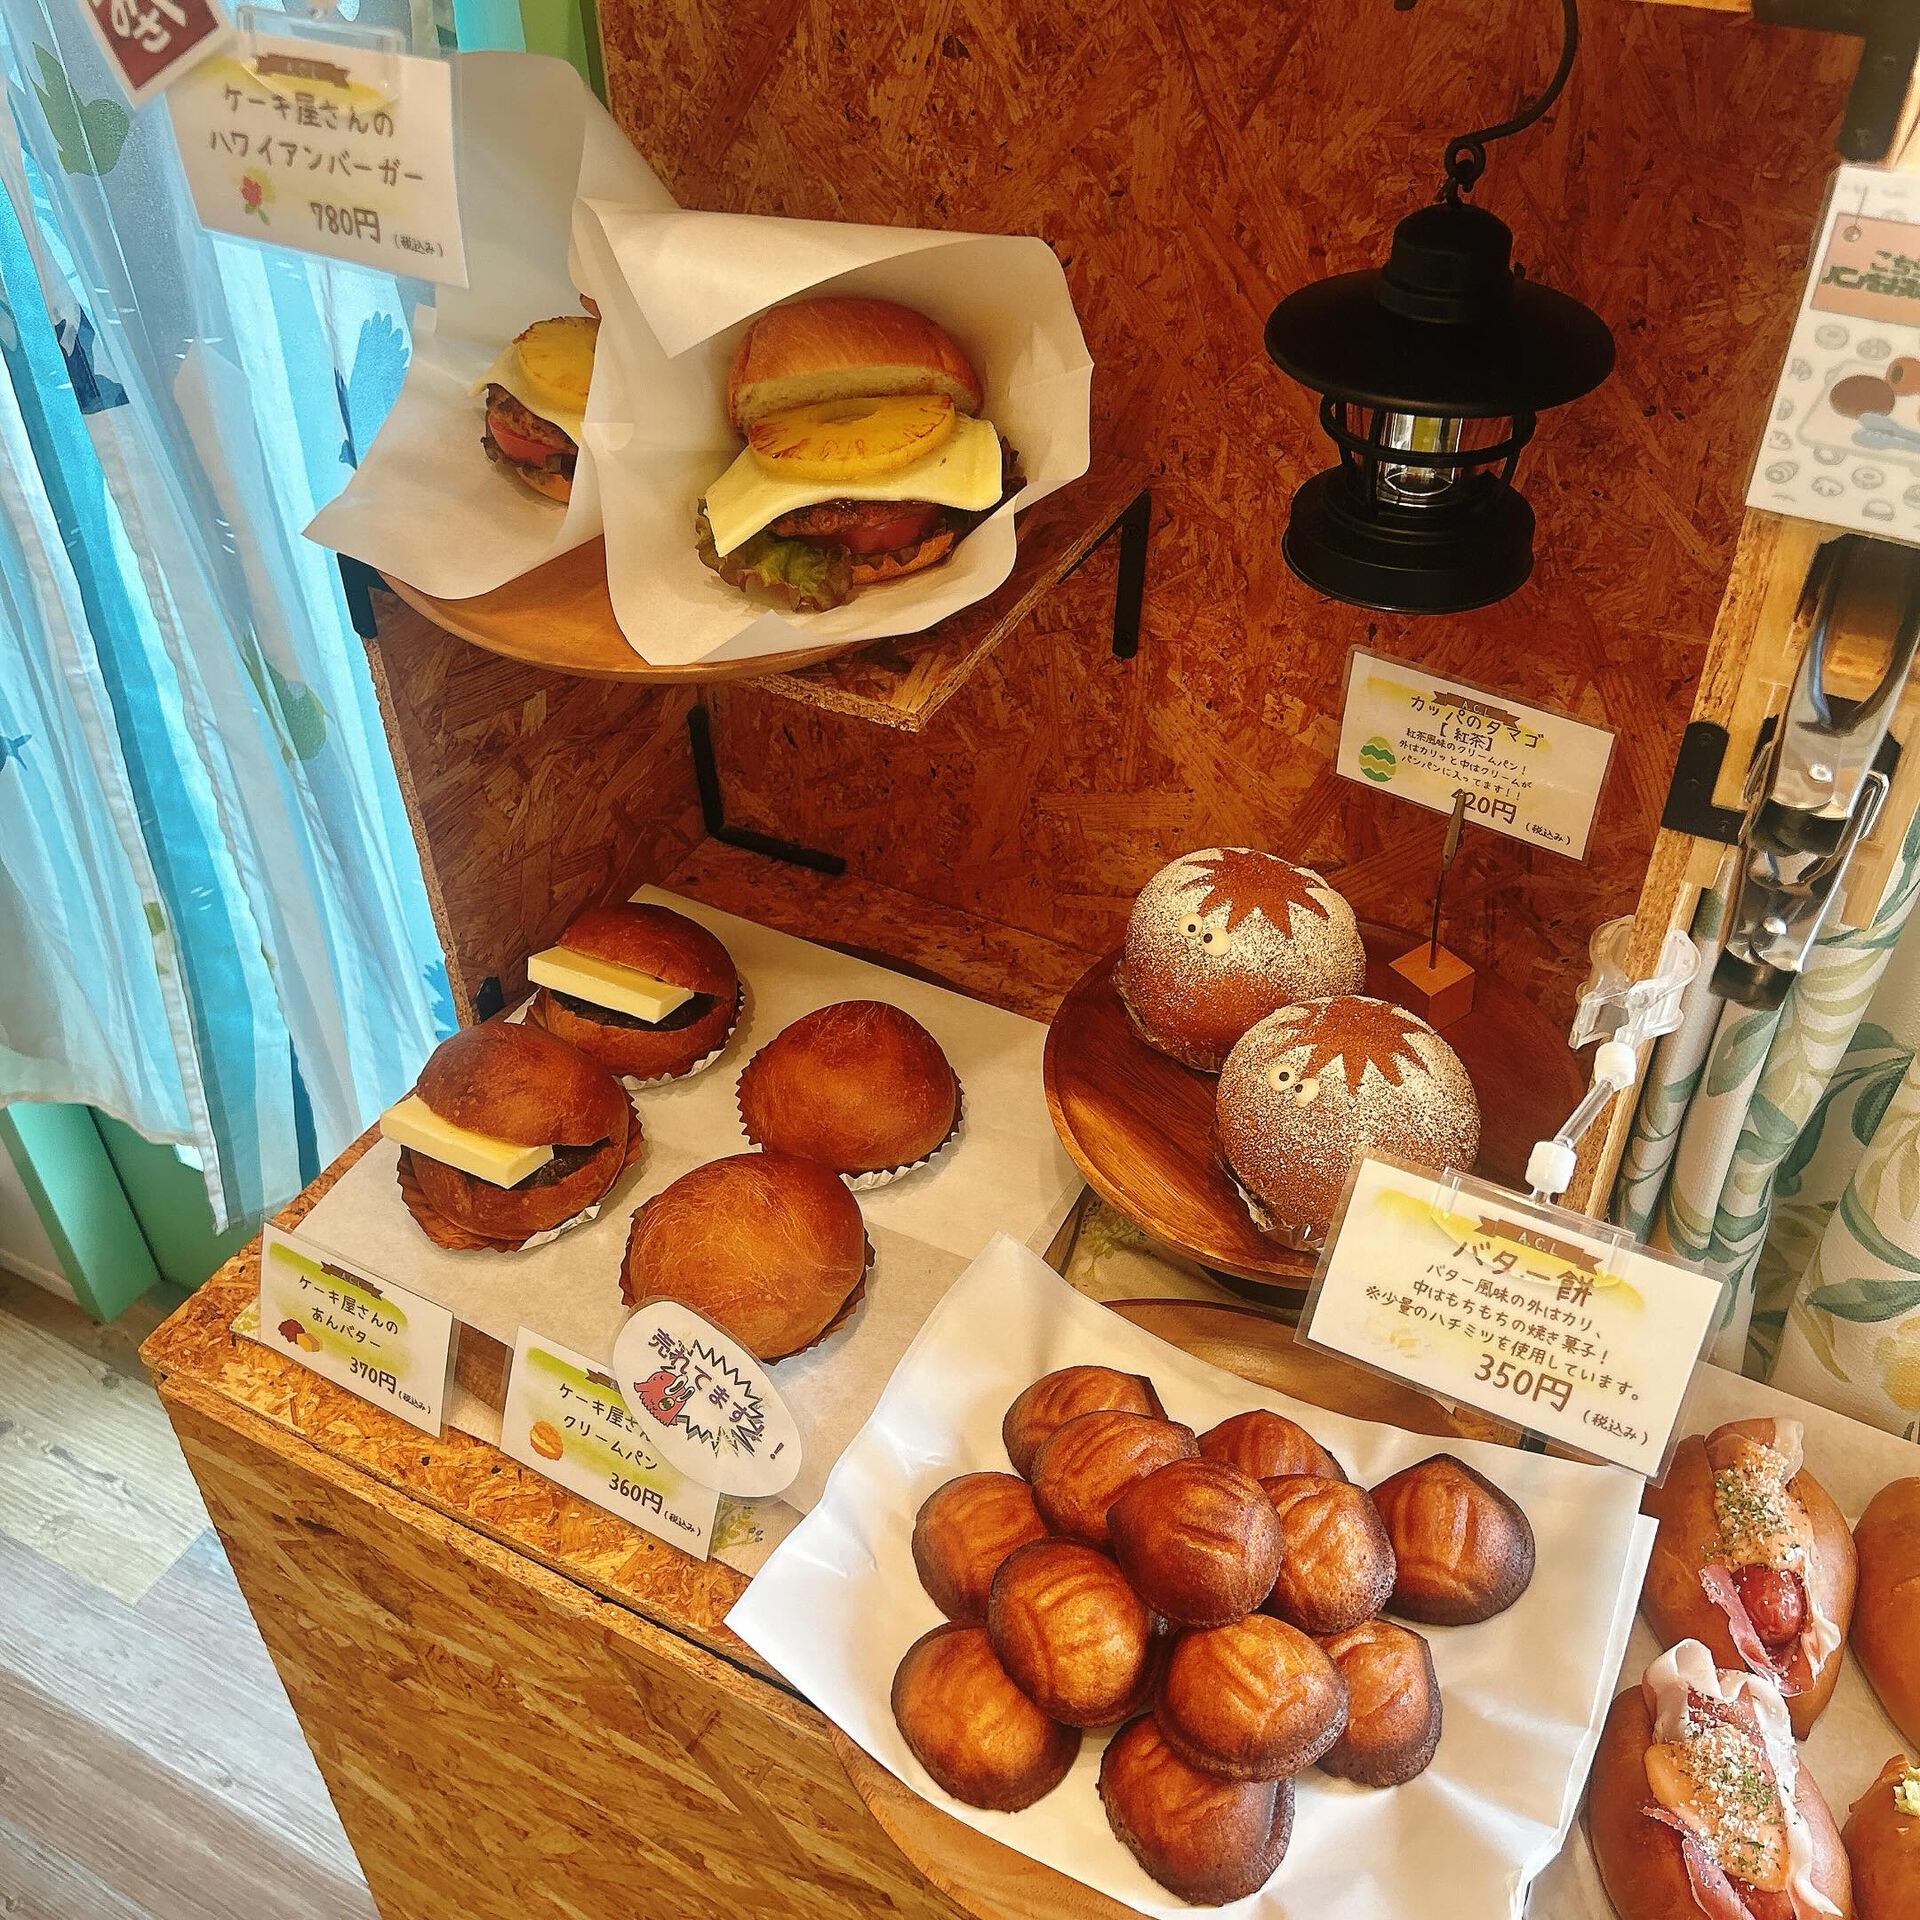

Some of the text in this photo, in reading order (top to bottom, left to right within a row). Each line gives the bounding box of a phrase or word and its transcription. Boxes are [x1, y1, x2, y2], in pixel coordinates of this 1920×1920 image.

[224, 83, 395, 138] ケーキ屋さんの
[210, 131, 424, 187] ハワイアンバーガー
[310, 201, 381, 244] 780円
[1411, 695, 1544, 749] カッパのタマゴ
[1399, 739, 1533, 789] 外はカリッと中はクリームが
[1525, 822, 1571, 846] (税込み)
[1426, 1264, 1601, 1339] バター風味の外はカリ、
[1452, 1241, 1595, 1308] バター餅
[299, 1275, 398, 1335] ケーキ屋さんの
[311, 1306, 381, 1349] あんバター
[1412, 1279, 1609, 1365] 中はもちもちの焼き菓子!
[1365, 1285, 1639, 1401] ※少量のハチミツを使用しています。
[350, 1356, 397, 1395] 370円
[1474, 1353, 1649, 1446] 350円 (税込み)
[563, 1414, 658, 1471] クリームパン
[608, 1472, 702, 1537] 360円 (税込み)
